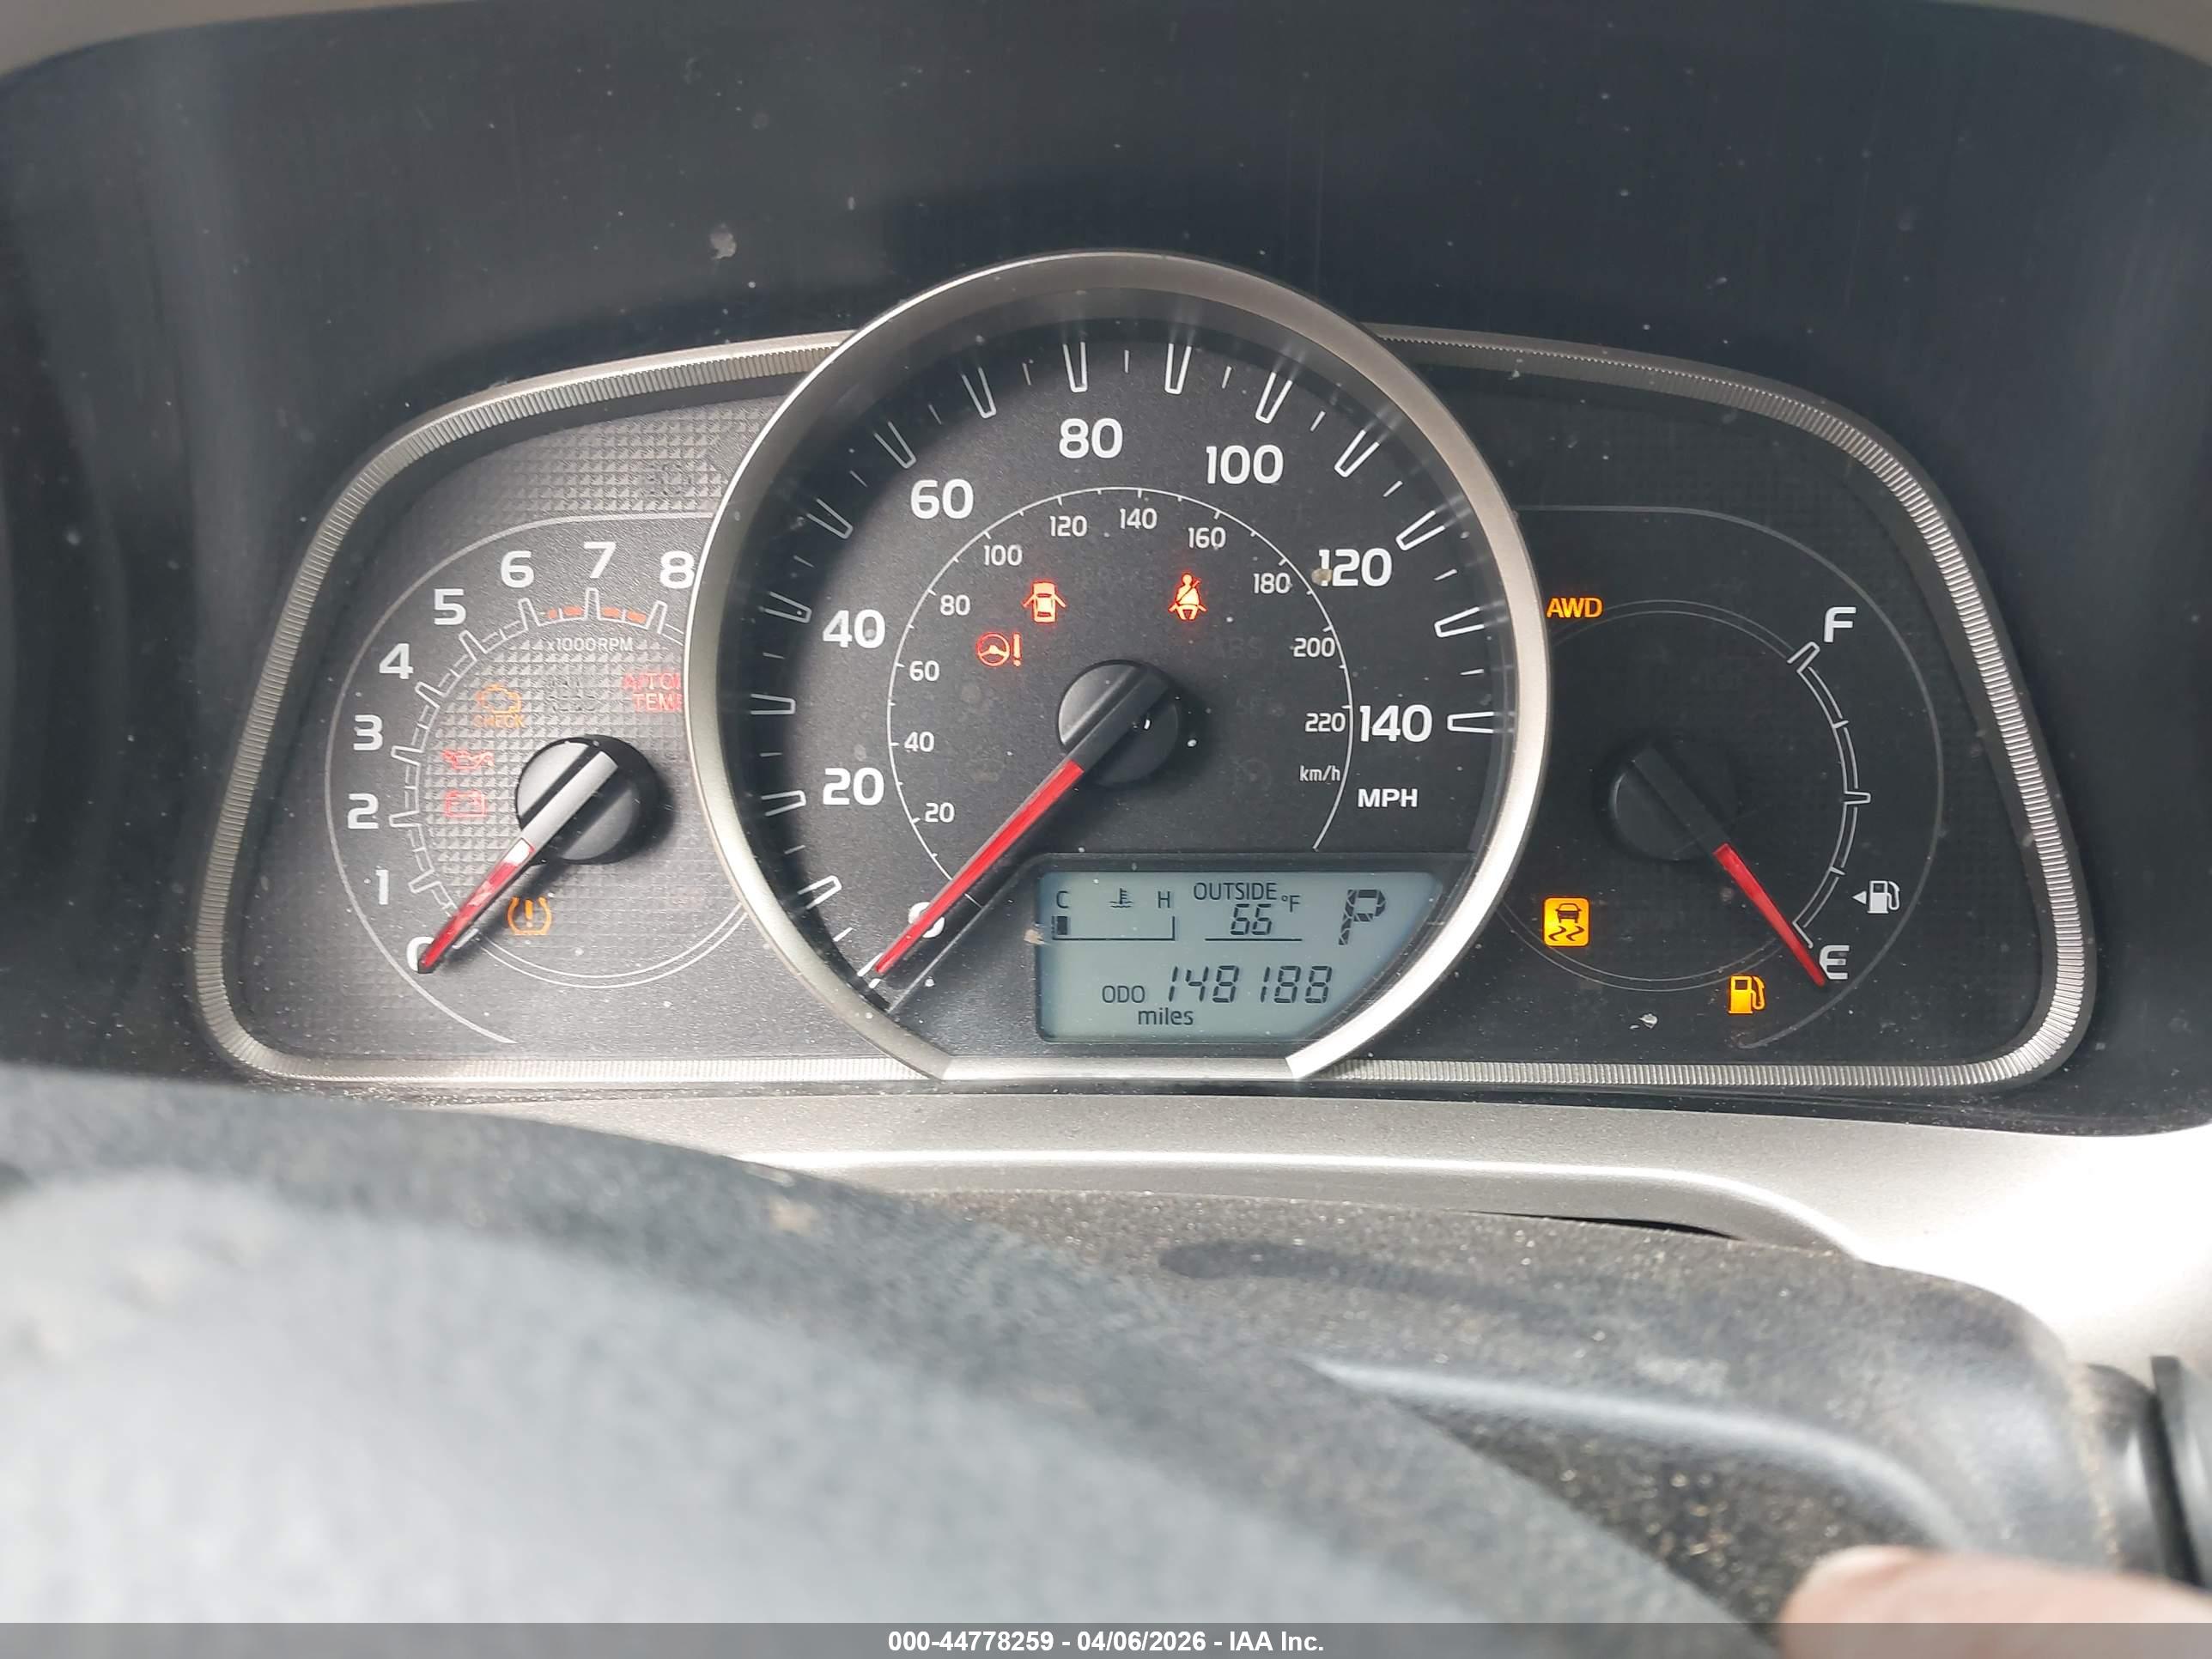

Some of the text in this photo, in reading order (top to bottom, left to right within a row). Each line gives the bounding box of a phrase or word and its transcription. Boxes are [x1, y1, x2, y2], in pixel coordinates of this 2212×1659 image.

[1059, 417, 1123, 459] 80
[1206, 444, 1284, 484] 100
[910, 477, 975, 520] 60
[1049, 514, 1088, 538] 120
[1119, 507, 1158, 530] 140
[982, 544, 1023, 567] 100
[1188, 526, 1226, 550] 160
[500, 550, 535, 588] 6
[584, 541, 617, 580] 7
[659, 550, 696, 589] 8
[1318, 548, 1393, 587] 120
[1253, 573, 1291, 594] 180
[434, 588, 467, 626] 5
[939, 593, 971, 617] 80
[1547, 597, 1603, 619] AWD
[822, 609, 886, 649] 40
[1824, 606, 1856, 643] F
[379, 642, 414, 680] 4
[1293, 636, 1336, 658] 200
[908, 658, 940, 682] 60
[353, 714, 384, 751] 3
[473, 714, 527, 728] CHECK
[1304, 712, 1346, 732] 220
[1359, 704, 1432, 743] 140
[902, 731, 935, 754] 40
[823, 767, 885, 806] 20
[1299, 764, 1341, 782] km/h
[347, 793, 378, 830] 2
[924, 801, 956, 823] 20
[1358, 788, 1418, 808] MPH
[375, 869, 390, 906] 1
[1055, 890, 1070, 909] C
[1157, 890, 1171, 910] H
[1193, 882, 1278, 902] OUTSIDE
[1230, 902, 1273, 937] 66
[1338, 888, 1387, 946] P
[1818, 945, 1850, 981] E
[1102, 964, 1334, 1005] ODO 148188
[1137, 1006, 1194, 1028] miles
